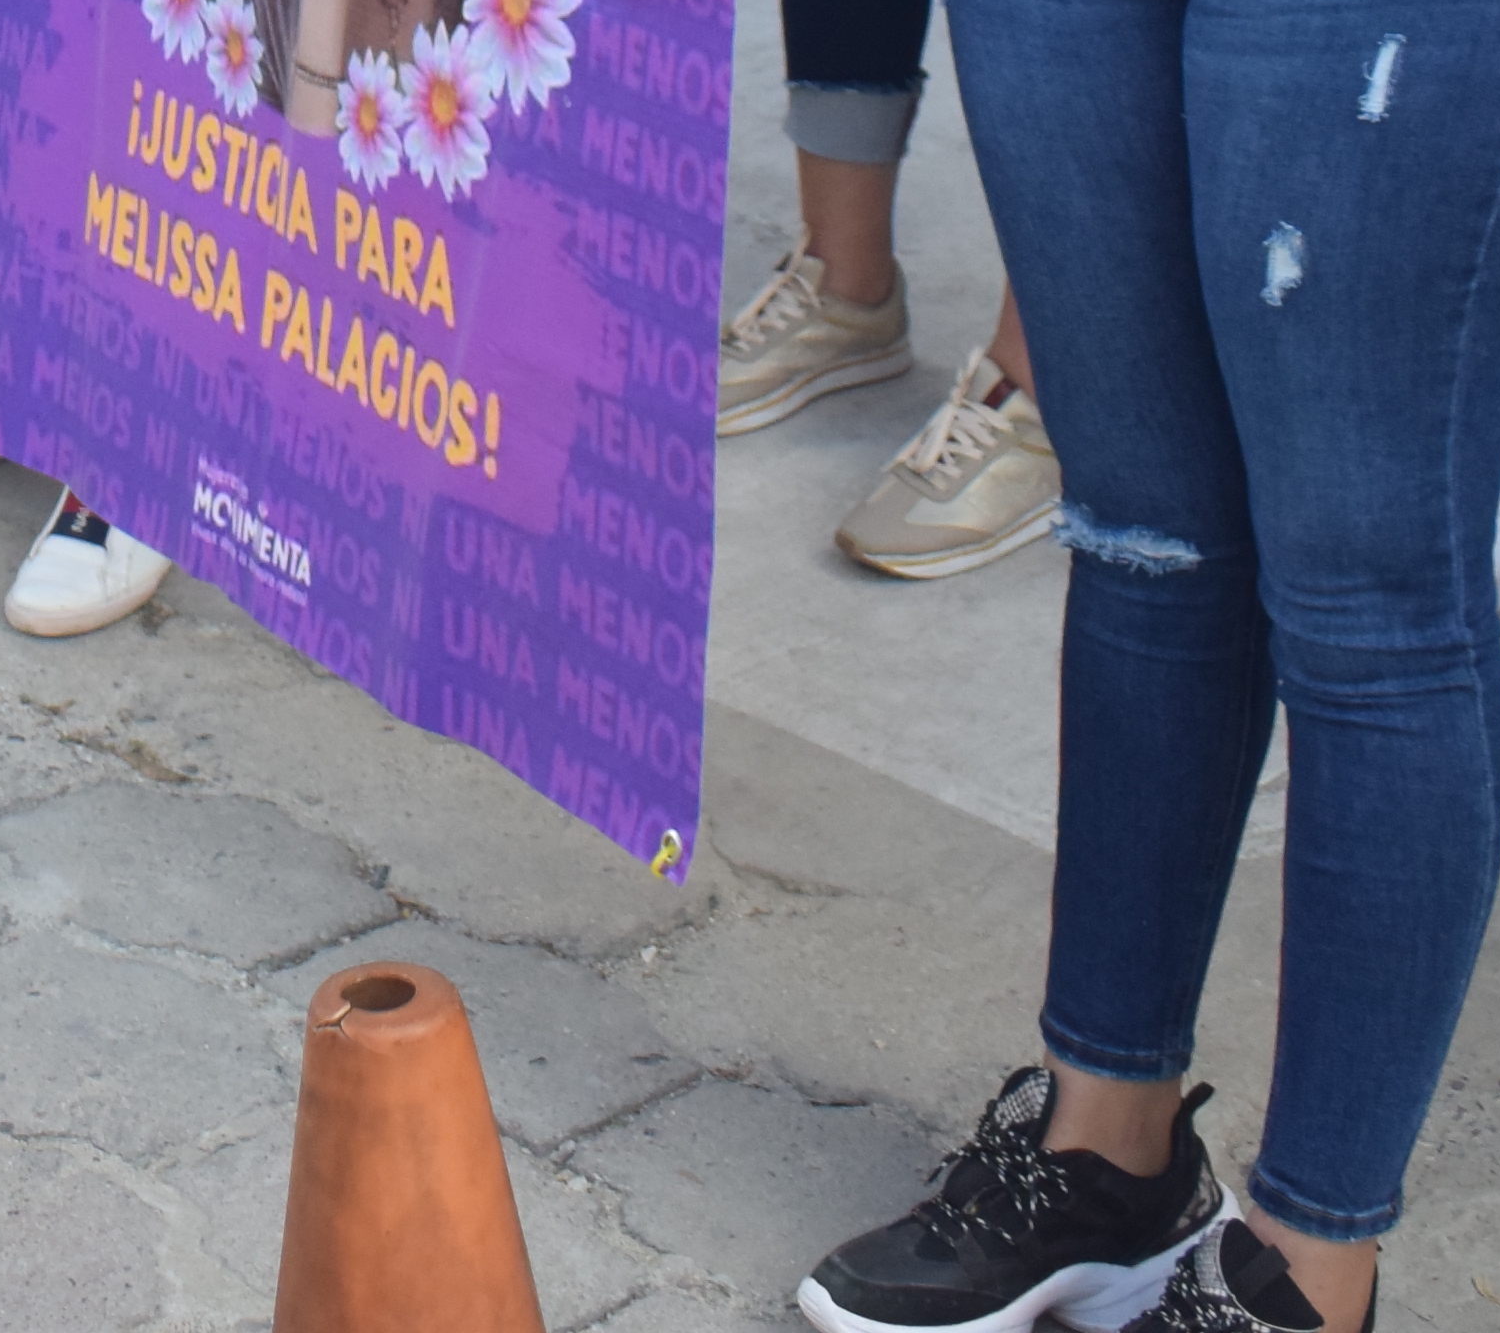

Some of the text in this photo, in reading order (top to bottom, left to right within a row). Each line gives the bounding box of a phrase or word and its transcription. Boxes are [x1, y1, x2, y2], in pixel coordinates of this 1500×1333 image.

[586, 11, 734, 129] MENOS
[126, 79, 457, 327] ¡JUSTICIA PARA
[581, 103, 728, 225] MENOS
[85, 169, 502, 480] MELISSA PALACIOS!
[444, 503, 541, 608] UNA
[558, 565, 711, 701] MENOS
[561, 474, 715, 607] MENOS
[442, 597, 540, 700] UNA
[556, 655, 706, 796] MENOS
[548, 743, 680, 866] MENO
